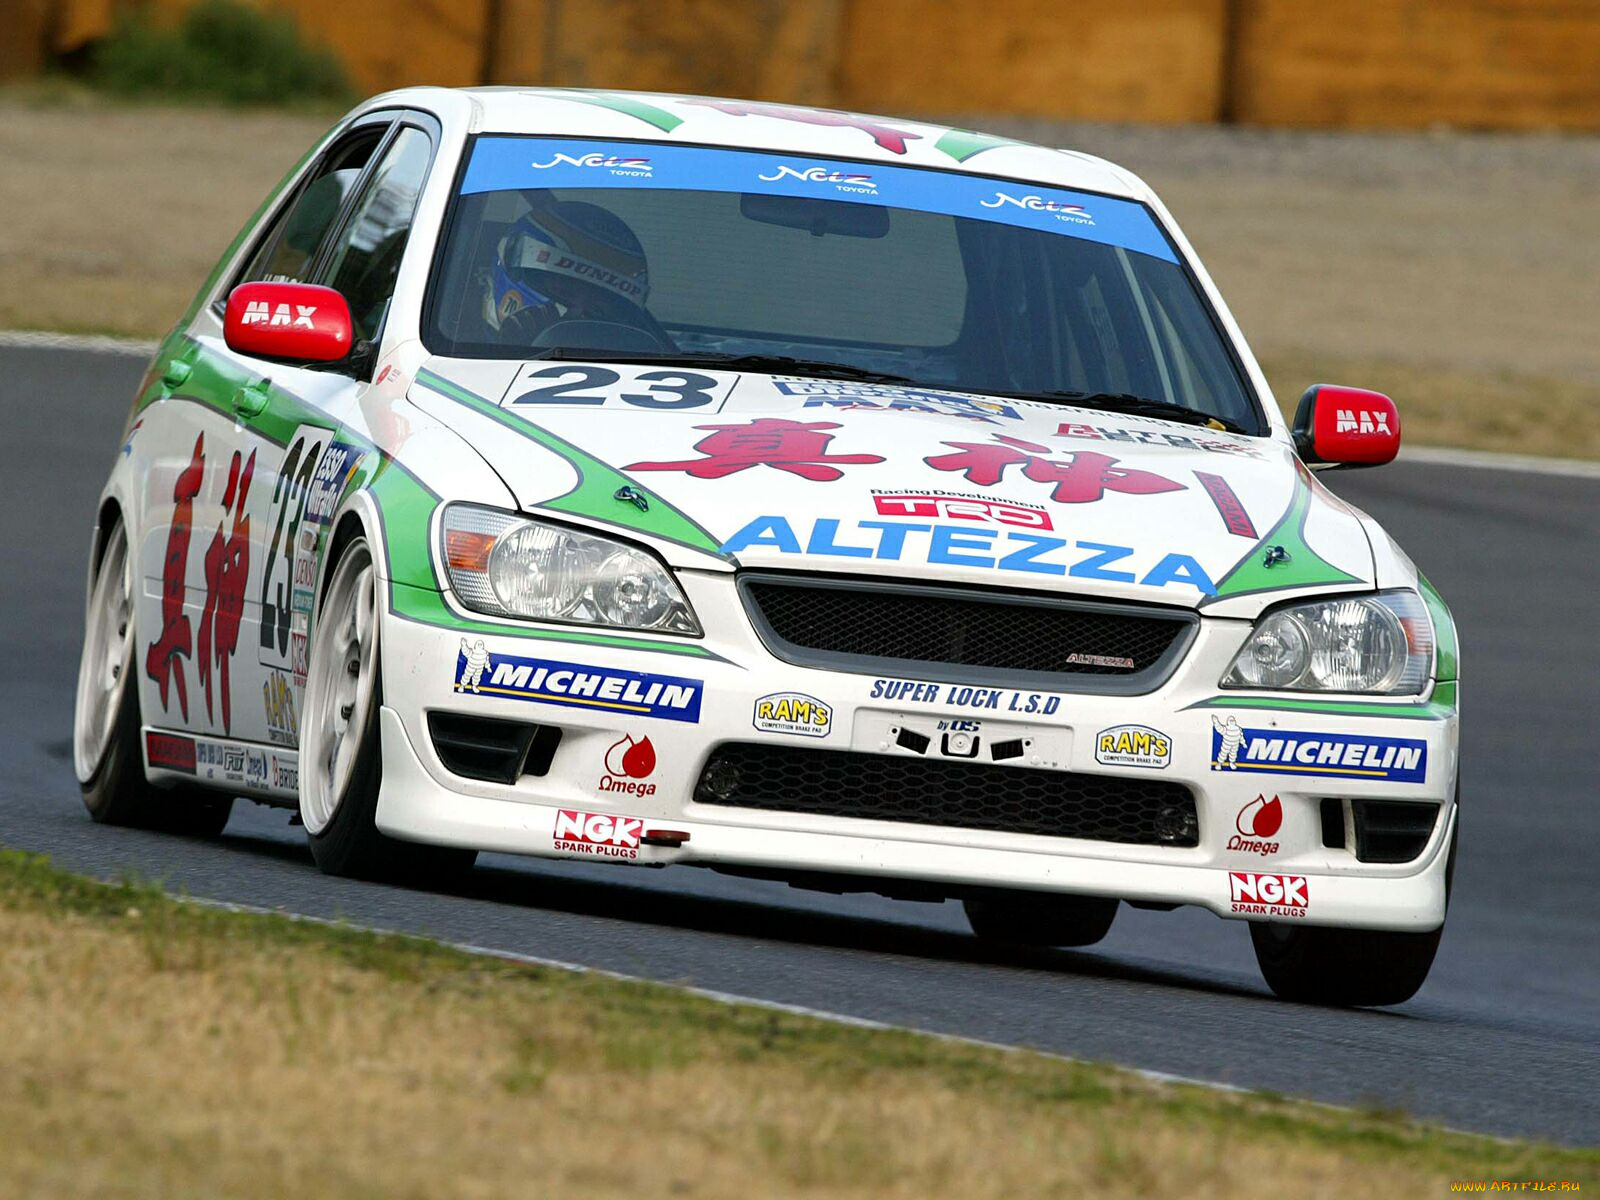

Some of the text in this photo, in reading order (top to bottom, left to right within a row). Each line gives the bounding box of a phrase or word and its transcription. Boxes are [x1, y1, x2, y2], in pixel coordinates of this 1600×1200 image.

[610, 169, 653, 178] TOYOTA
[836, 185, 879, 195] TOYOTA
[1054, 214, 1096, 226] TOYOTA
[554, 256, 642, 296] DUNLOP
[241, 301, 317, 330] MAX
[511, 365, 719, 410] 23
[1336, 409, 1392, 436] MAX
[878, 496, 1047, 529] TRD
[933, 489, 1048, 511] Development
[260, 436, 322, 658] 23
[719, 515, 1219, 598] ALTEZZA
[1066, 653, 1135, 669] ALTEZZA
[490, 662, 695, 709] MICHELIN
[870, 679, 1061, 715] SUPER LOCK L.S.D
[761, 722, 793, 731] COMPETITION
[795, 725, 810, 733] BRAKE
[936, 720, 949, 731] by
[1103, 754, 1134, 763] COMPETITION
[1246, 738, 1421, 770] MICHELIN
[555, 810, 643, 848] NGK
[554, 841, 637, 859] SPARK PLUGS
[1230, 872, 1309, 907] NGK
[1231, 903, 1306, 917] SPARK PLUGS
